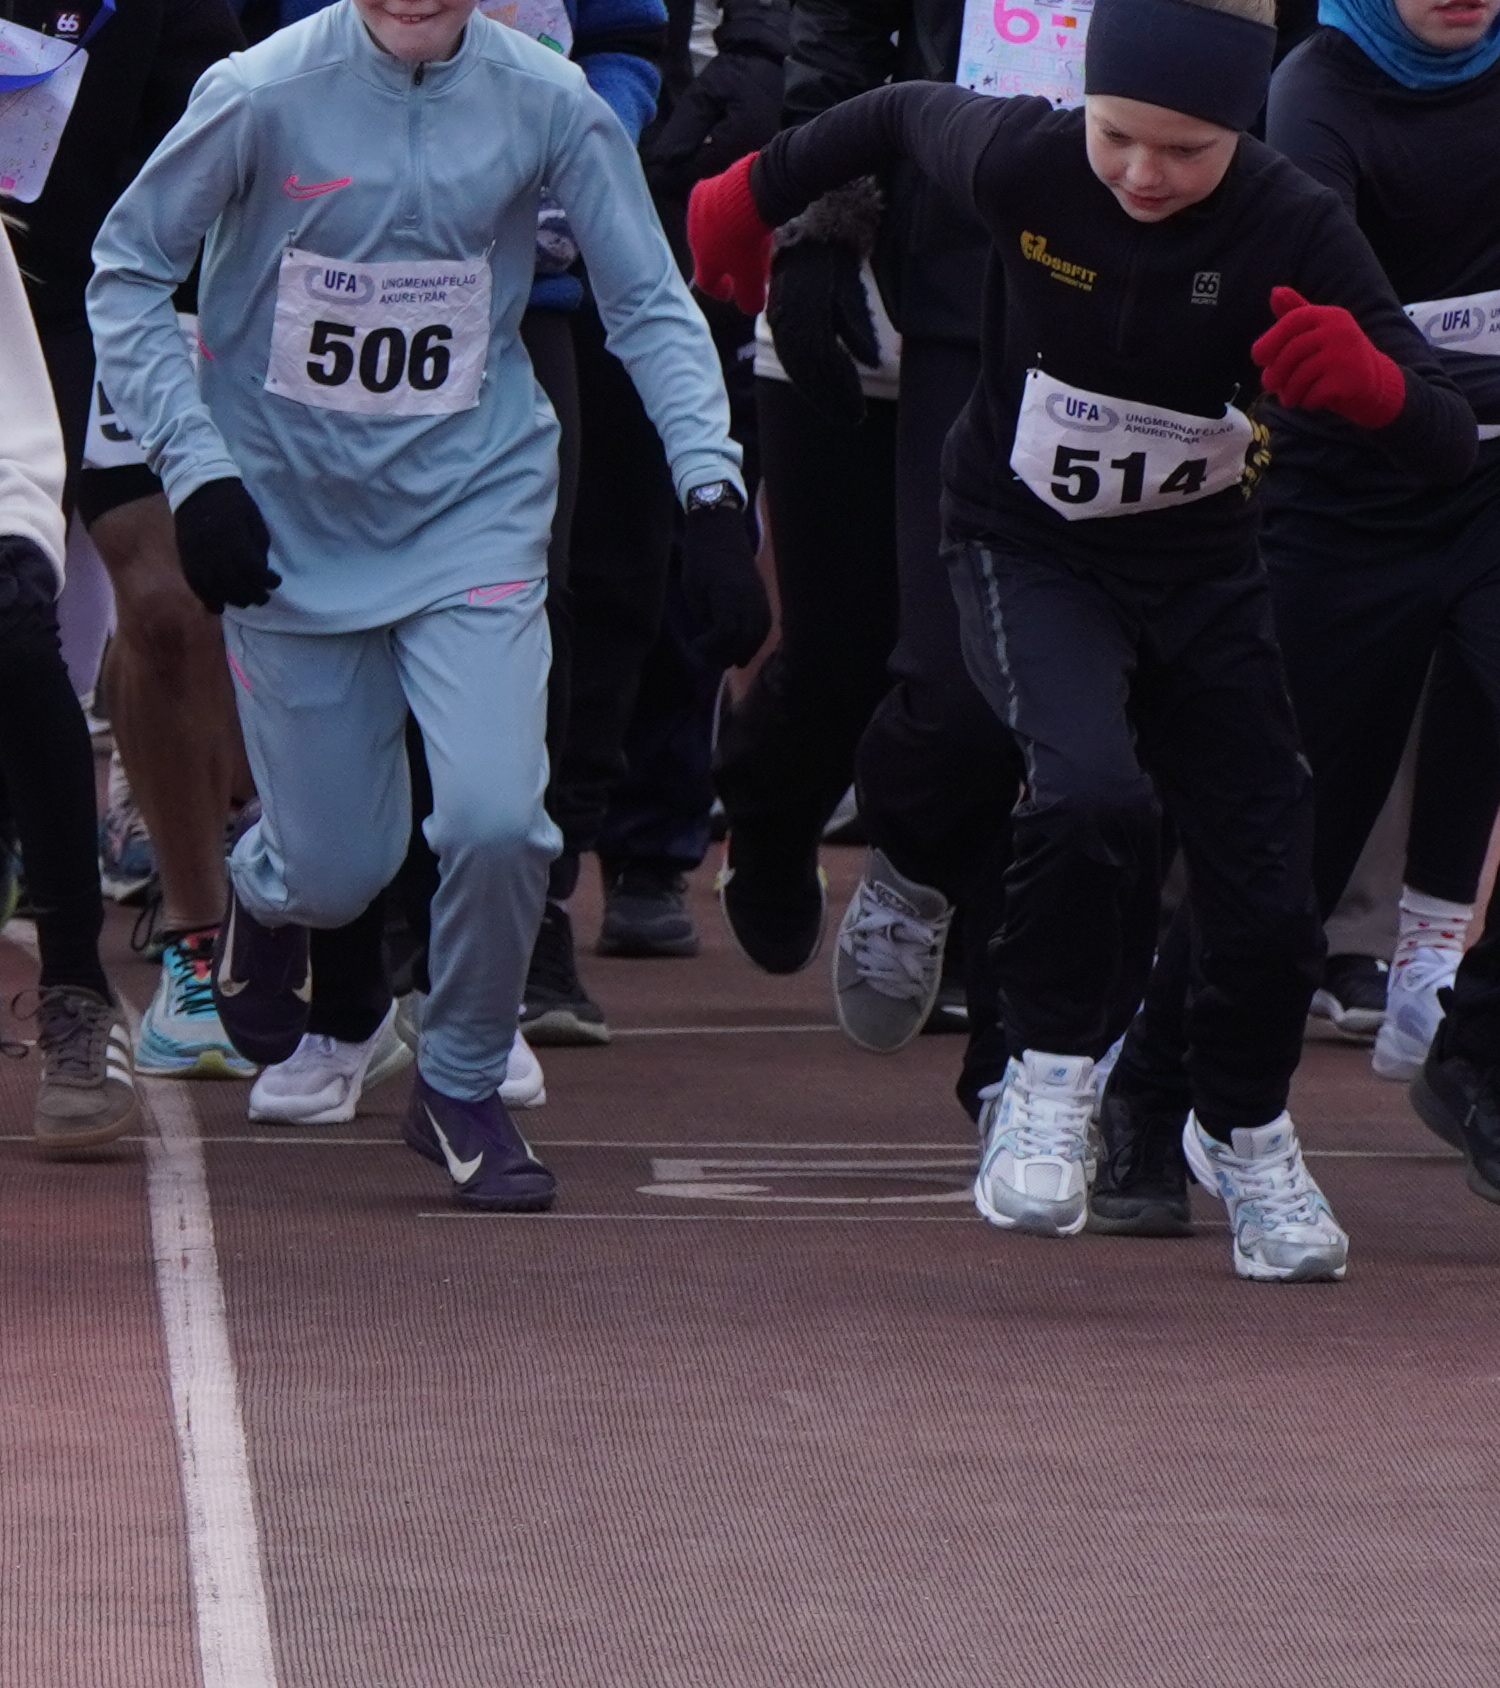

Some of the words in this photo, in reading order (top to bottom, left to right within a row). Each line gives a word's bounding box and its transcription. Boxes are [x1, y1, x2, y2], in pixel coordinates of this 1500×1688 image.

[324, 268, 358, 293] UFA
[379, 290, 448, 305] AKUREYRAR
[1441, 308, 1470, 332] UFA
[306, 319, 454, 394] 506
[1064, 396, 1100, 422] UFA
[1123, 423, 1201, 445] AKUREYRAR
[1050, 444, 1208, 505] 514
